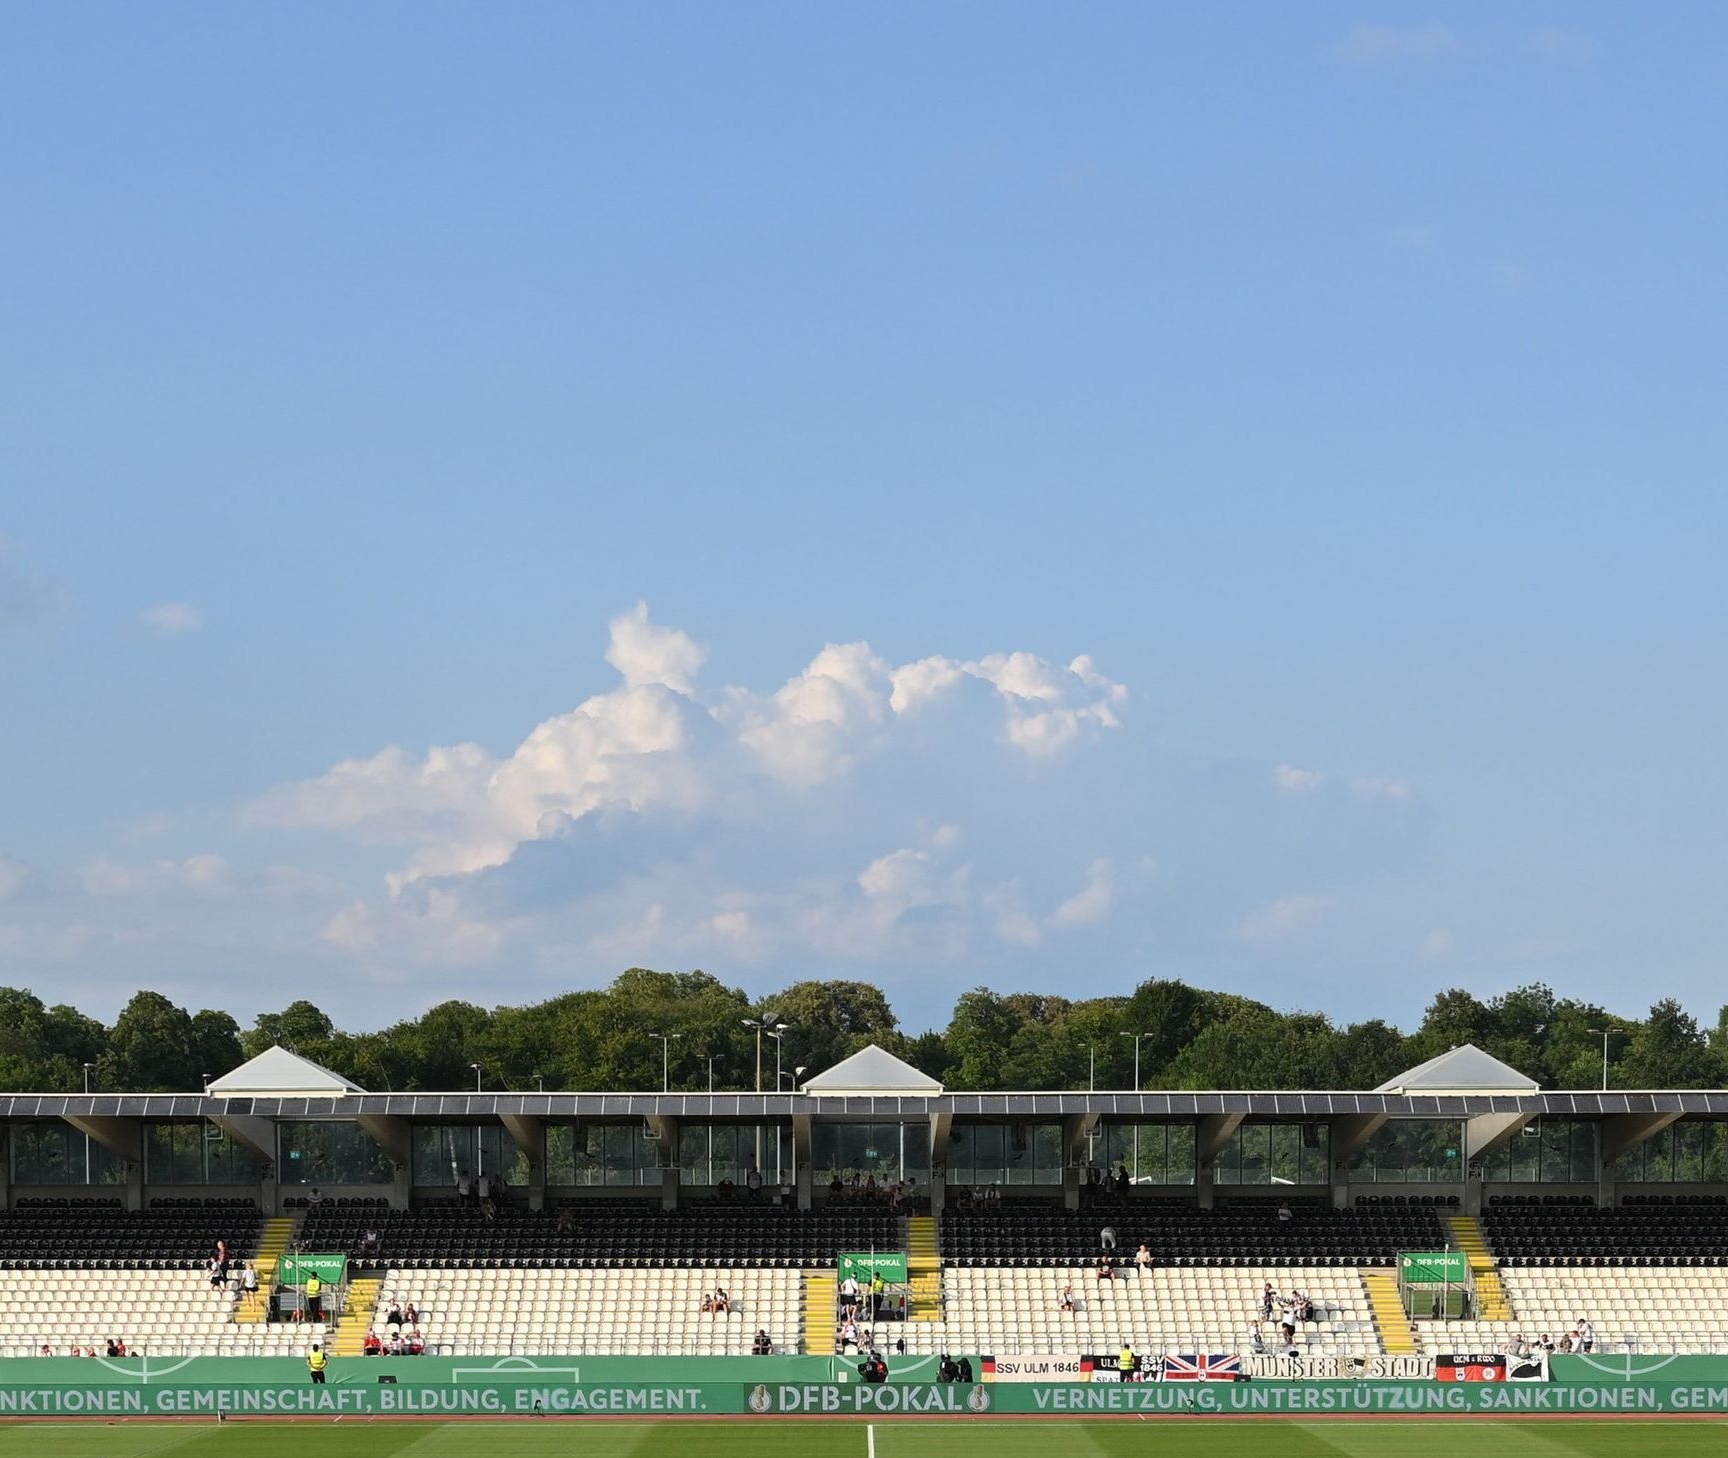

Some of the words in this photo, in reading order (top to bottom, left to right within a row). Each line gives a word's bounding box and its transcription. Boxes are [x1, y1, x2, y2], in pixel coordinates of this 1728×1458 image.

[996, 1363, 1020, 1374] SSV
[1024, 1362, 1049, 1373] ULM
[1052, 1361, 1080, 1373] 1846
[1140, 1364, 1163, 1372] 1846
[1141, 1356, 1164, 1365] SSV
[1371, 1357, 1432, 1378] STADT
[158, 1388, 372, 1413] GEMEINSCHAFT,
[380, 1389, 507, 1413] BILDUNG,
[515, 1388, 707, 1411] ENGAGEMENT.
[778, 1385, 963, 1411] DFB-POKAL
[1033, 1387, 1223, 1413] VERNETZUNG,
[1231, 1382, 1473, 1412] UNTERSTÜTZUNG,
[1480, 1387, 1663, 1411] SANKTIONEN,
